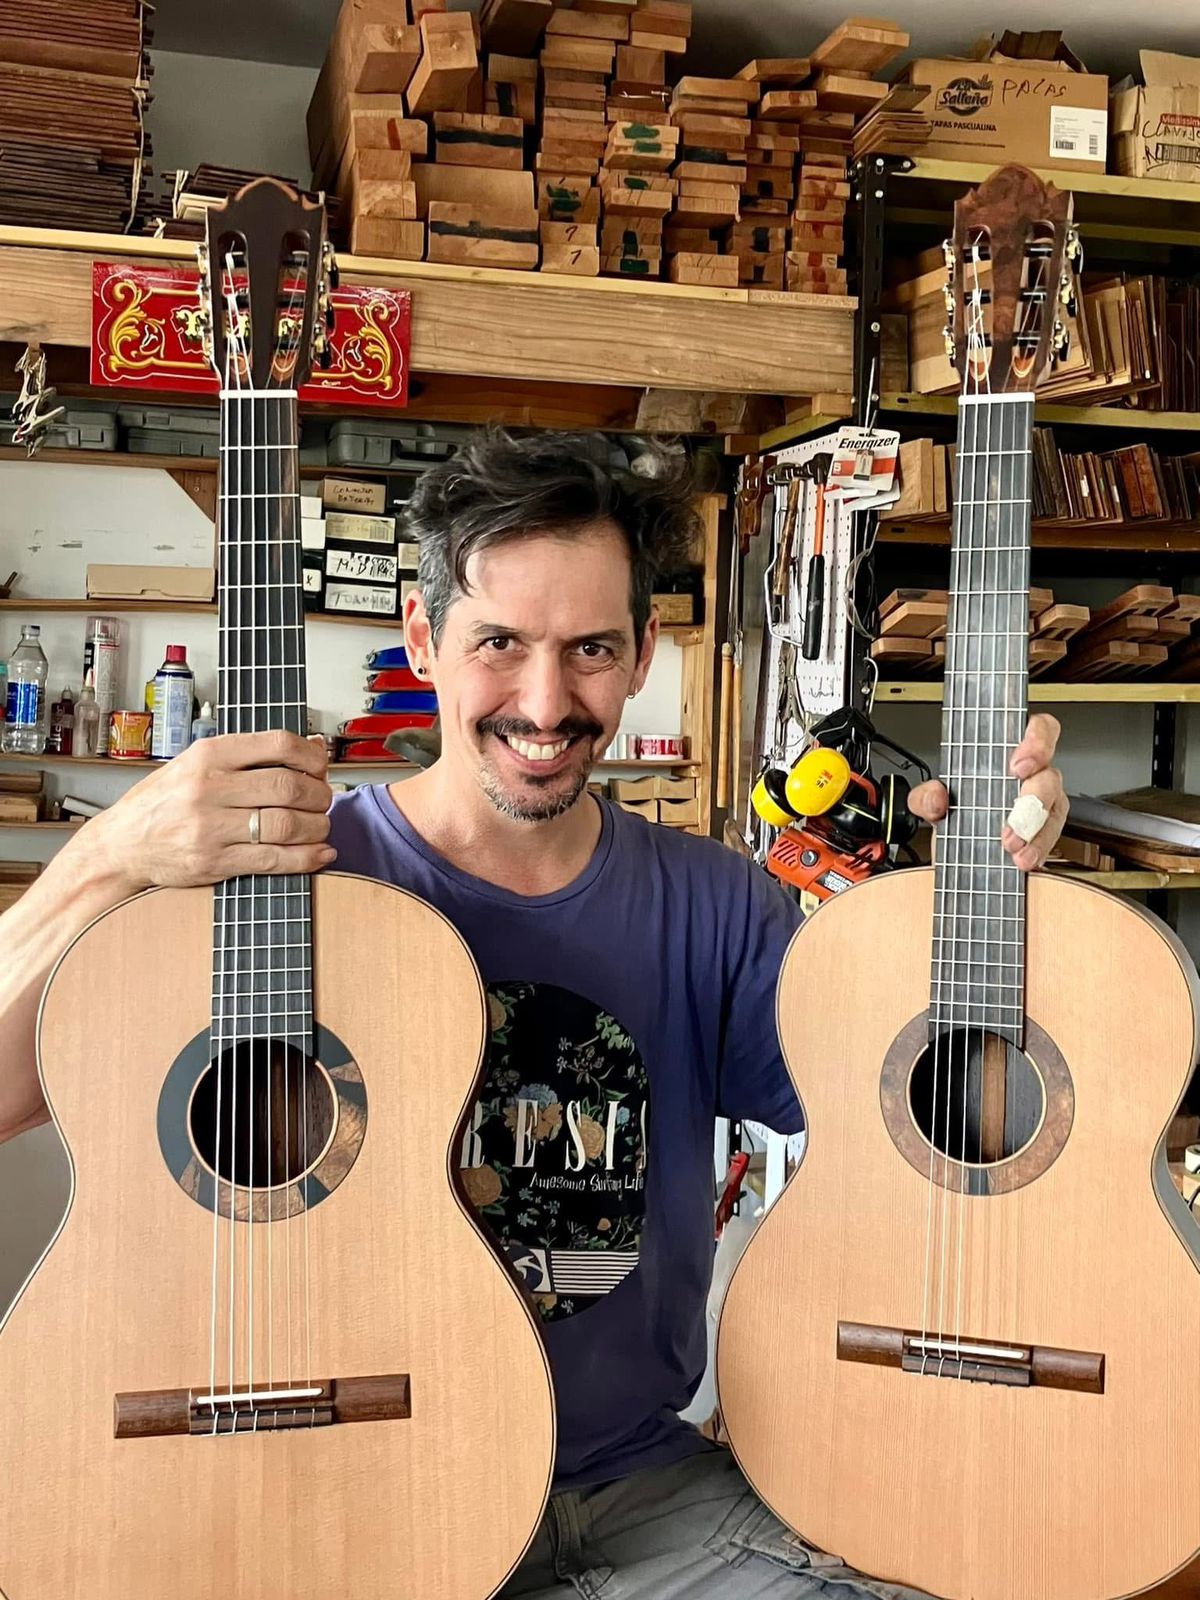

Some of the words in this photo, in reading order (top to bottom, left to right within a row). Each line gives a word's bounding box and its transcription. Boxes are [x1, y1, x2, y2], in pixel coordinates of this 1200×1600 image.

[939, 90, 989, 106] Salteña
[930, 120, 952, 129] TAPAS
[953, 122, 997, 132] PASCUALINA
[838, 436, 898, 450] Energizer
[529, 1171, 586, 1191] Awesome
